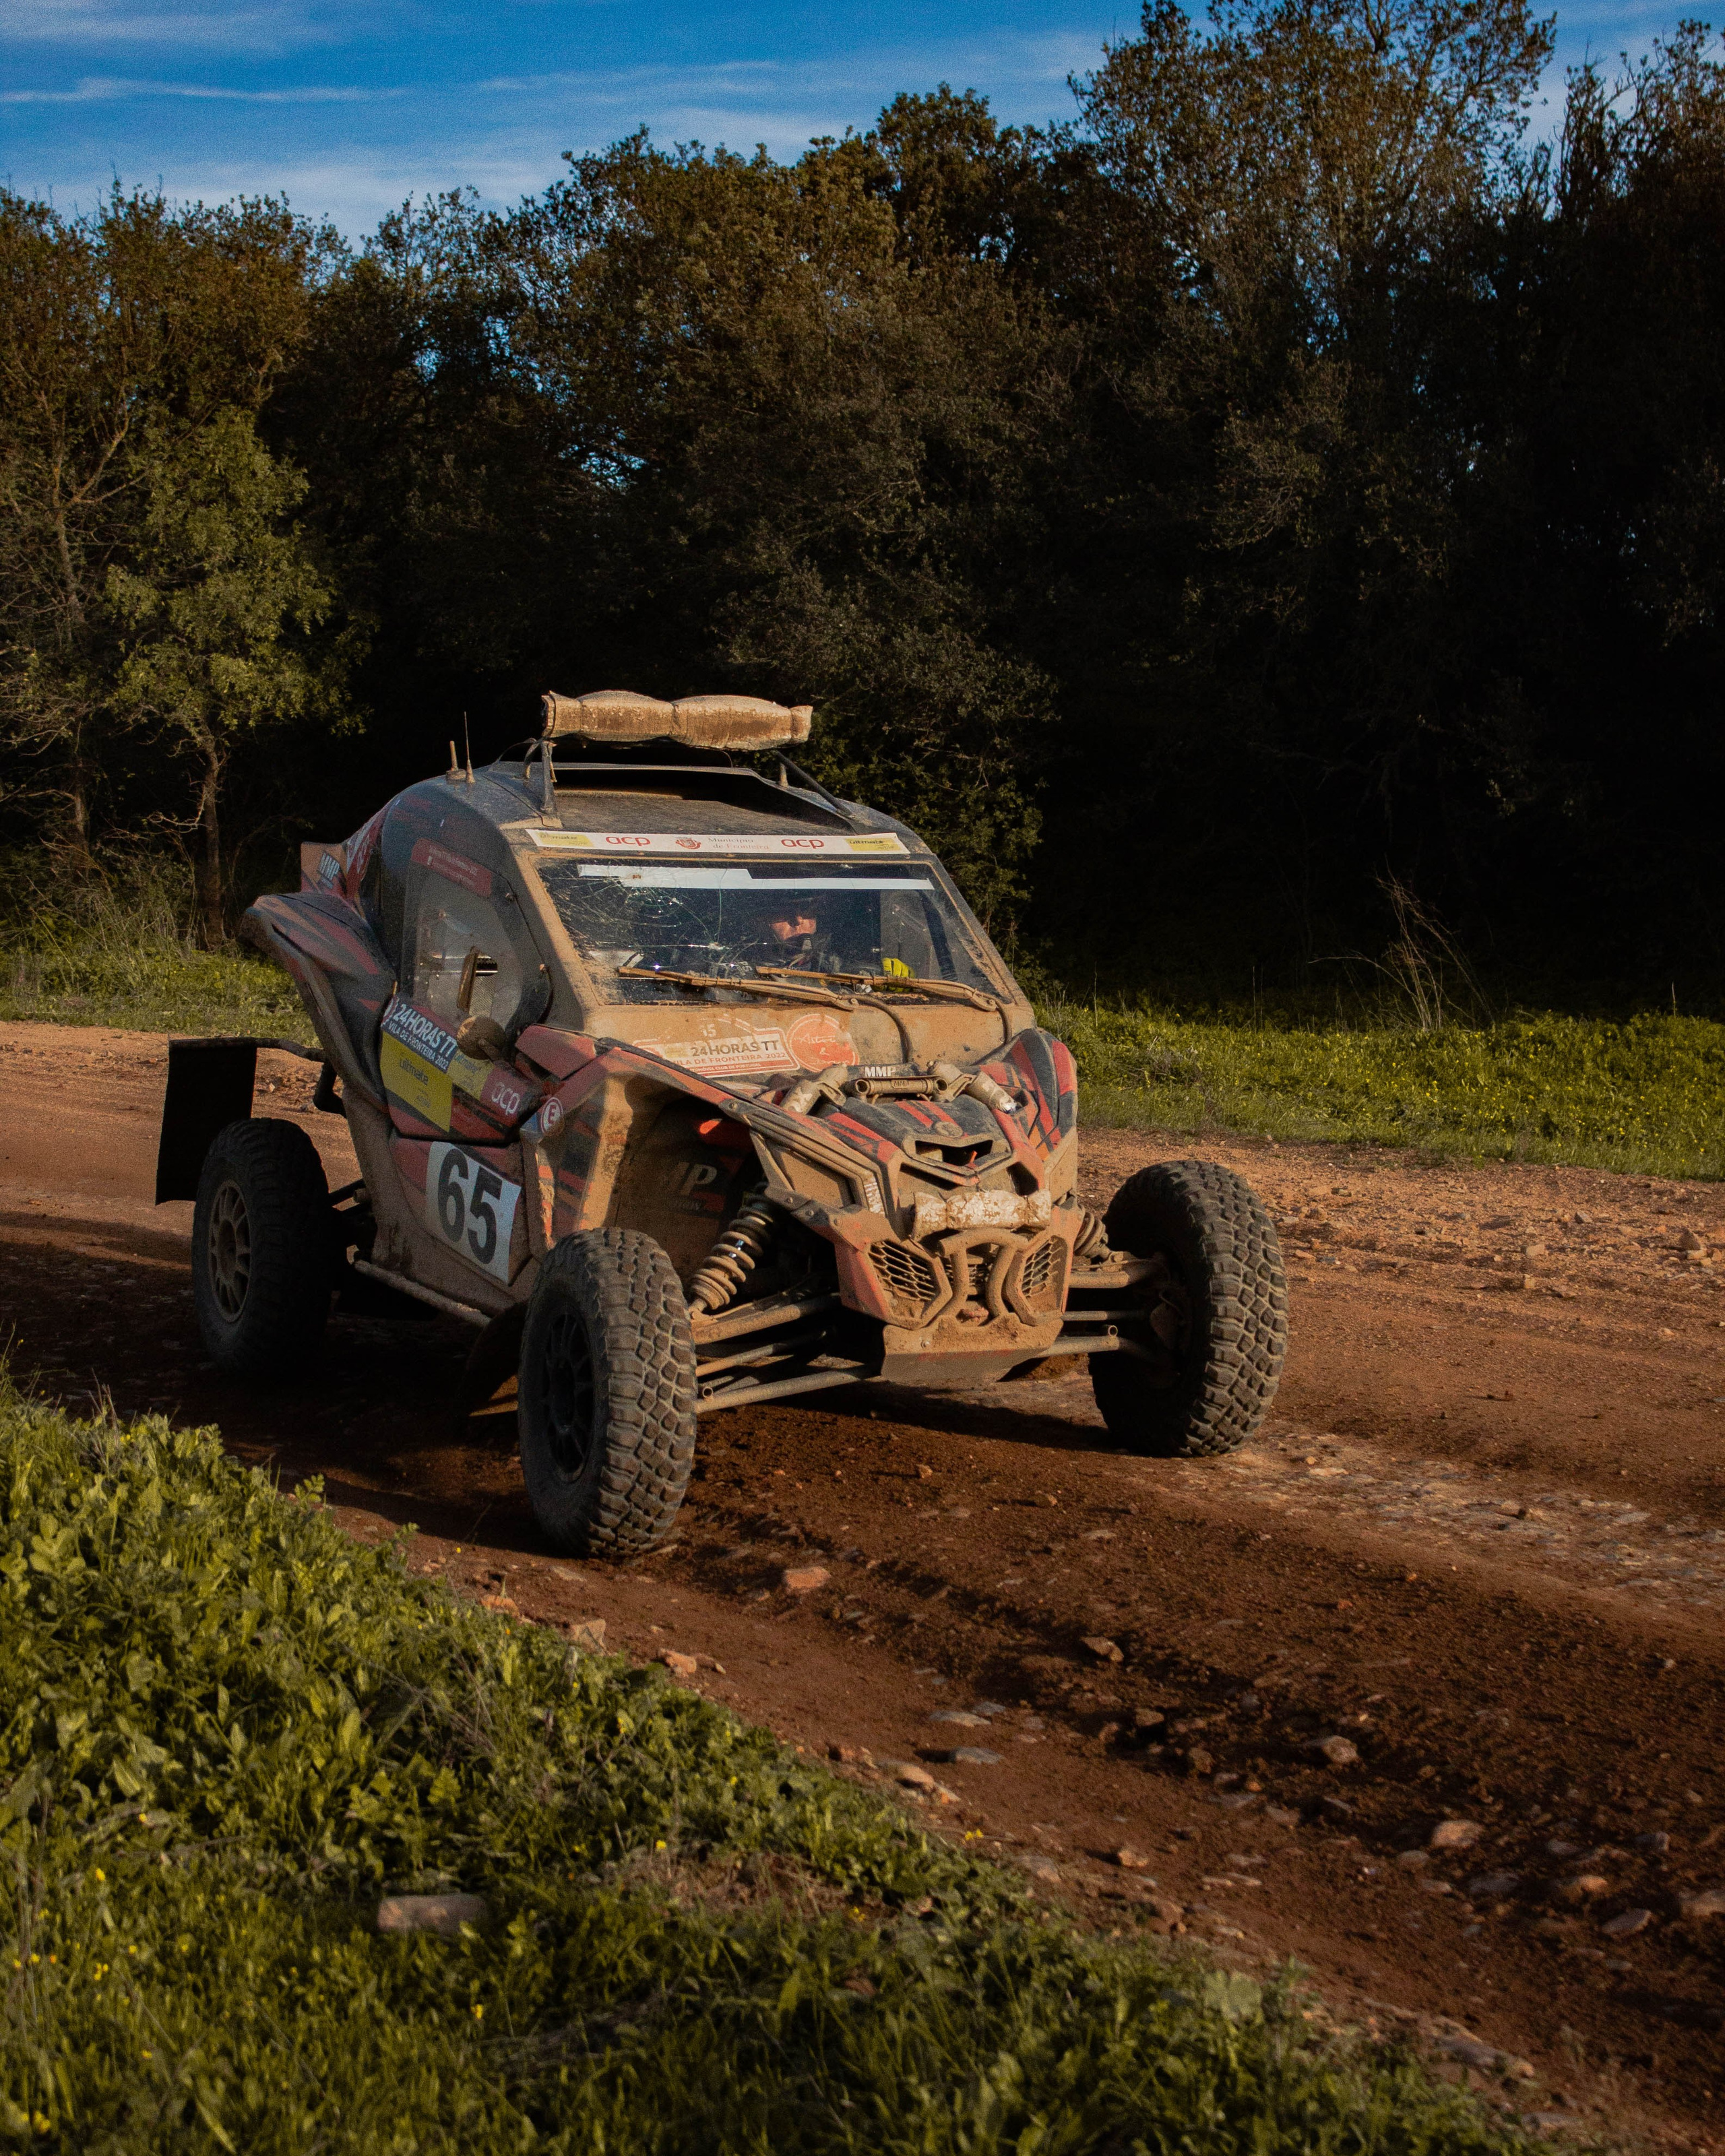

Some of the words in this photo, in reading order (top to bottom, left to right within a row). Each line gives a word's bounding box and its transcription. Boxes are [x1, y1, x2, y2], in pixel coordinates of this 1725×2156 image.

[606, 836, 651, 847] acp
[781, 838, 825, 850] acp
[388, 1021, 401, 1034] VILA
[435, 1055, 449, 1070] 2022
[761, 1040, 779, 1052] TT
[708, 1054, 763, 1064] FRONTEIRA
[865, 1066, 897, 1077] MMP
[491, 1081, 521, 1116] acp
[438, 1148, 504, 1265] 65
